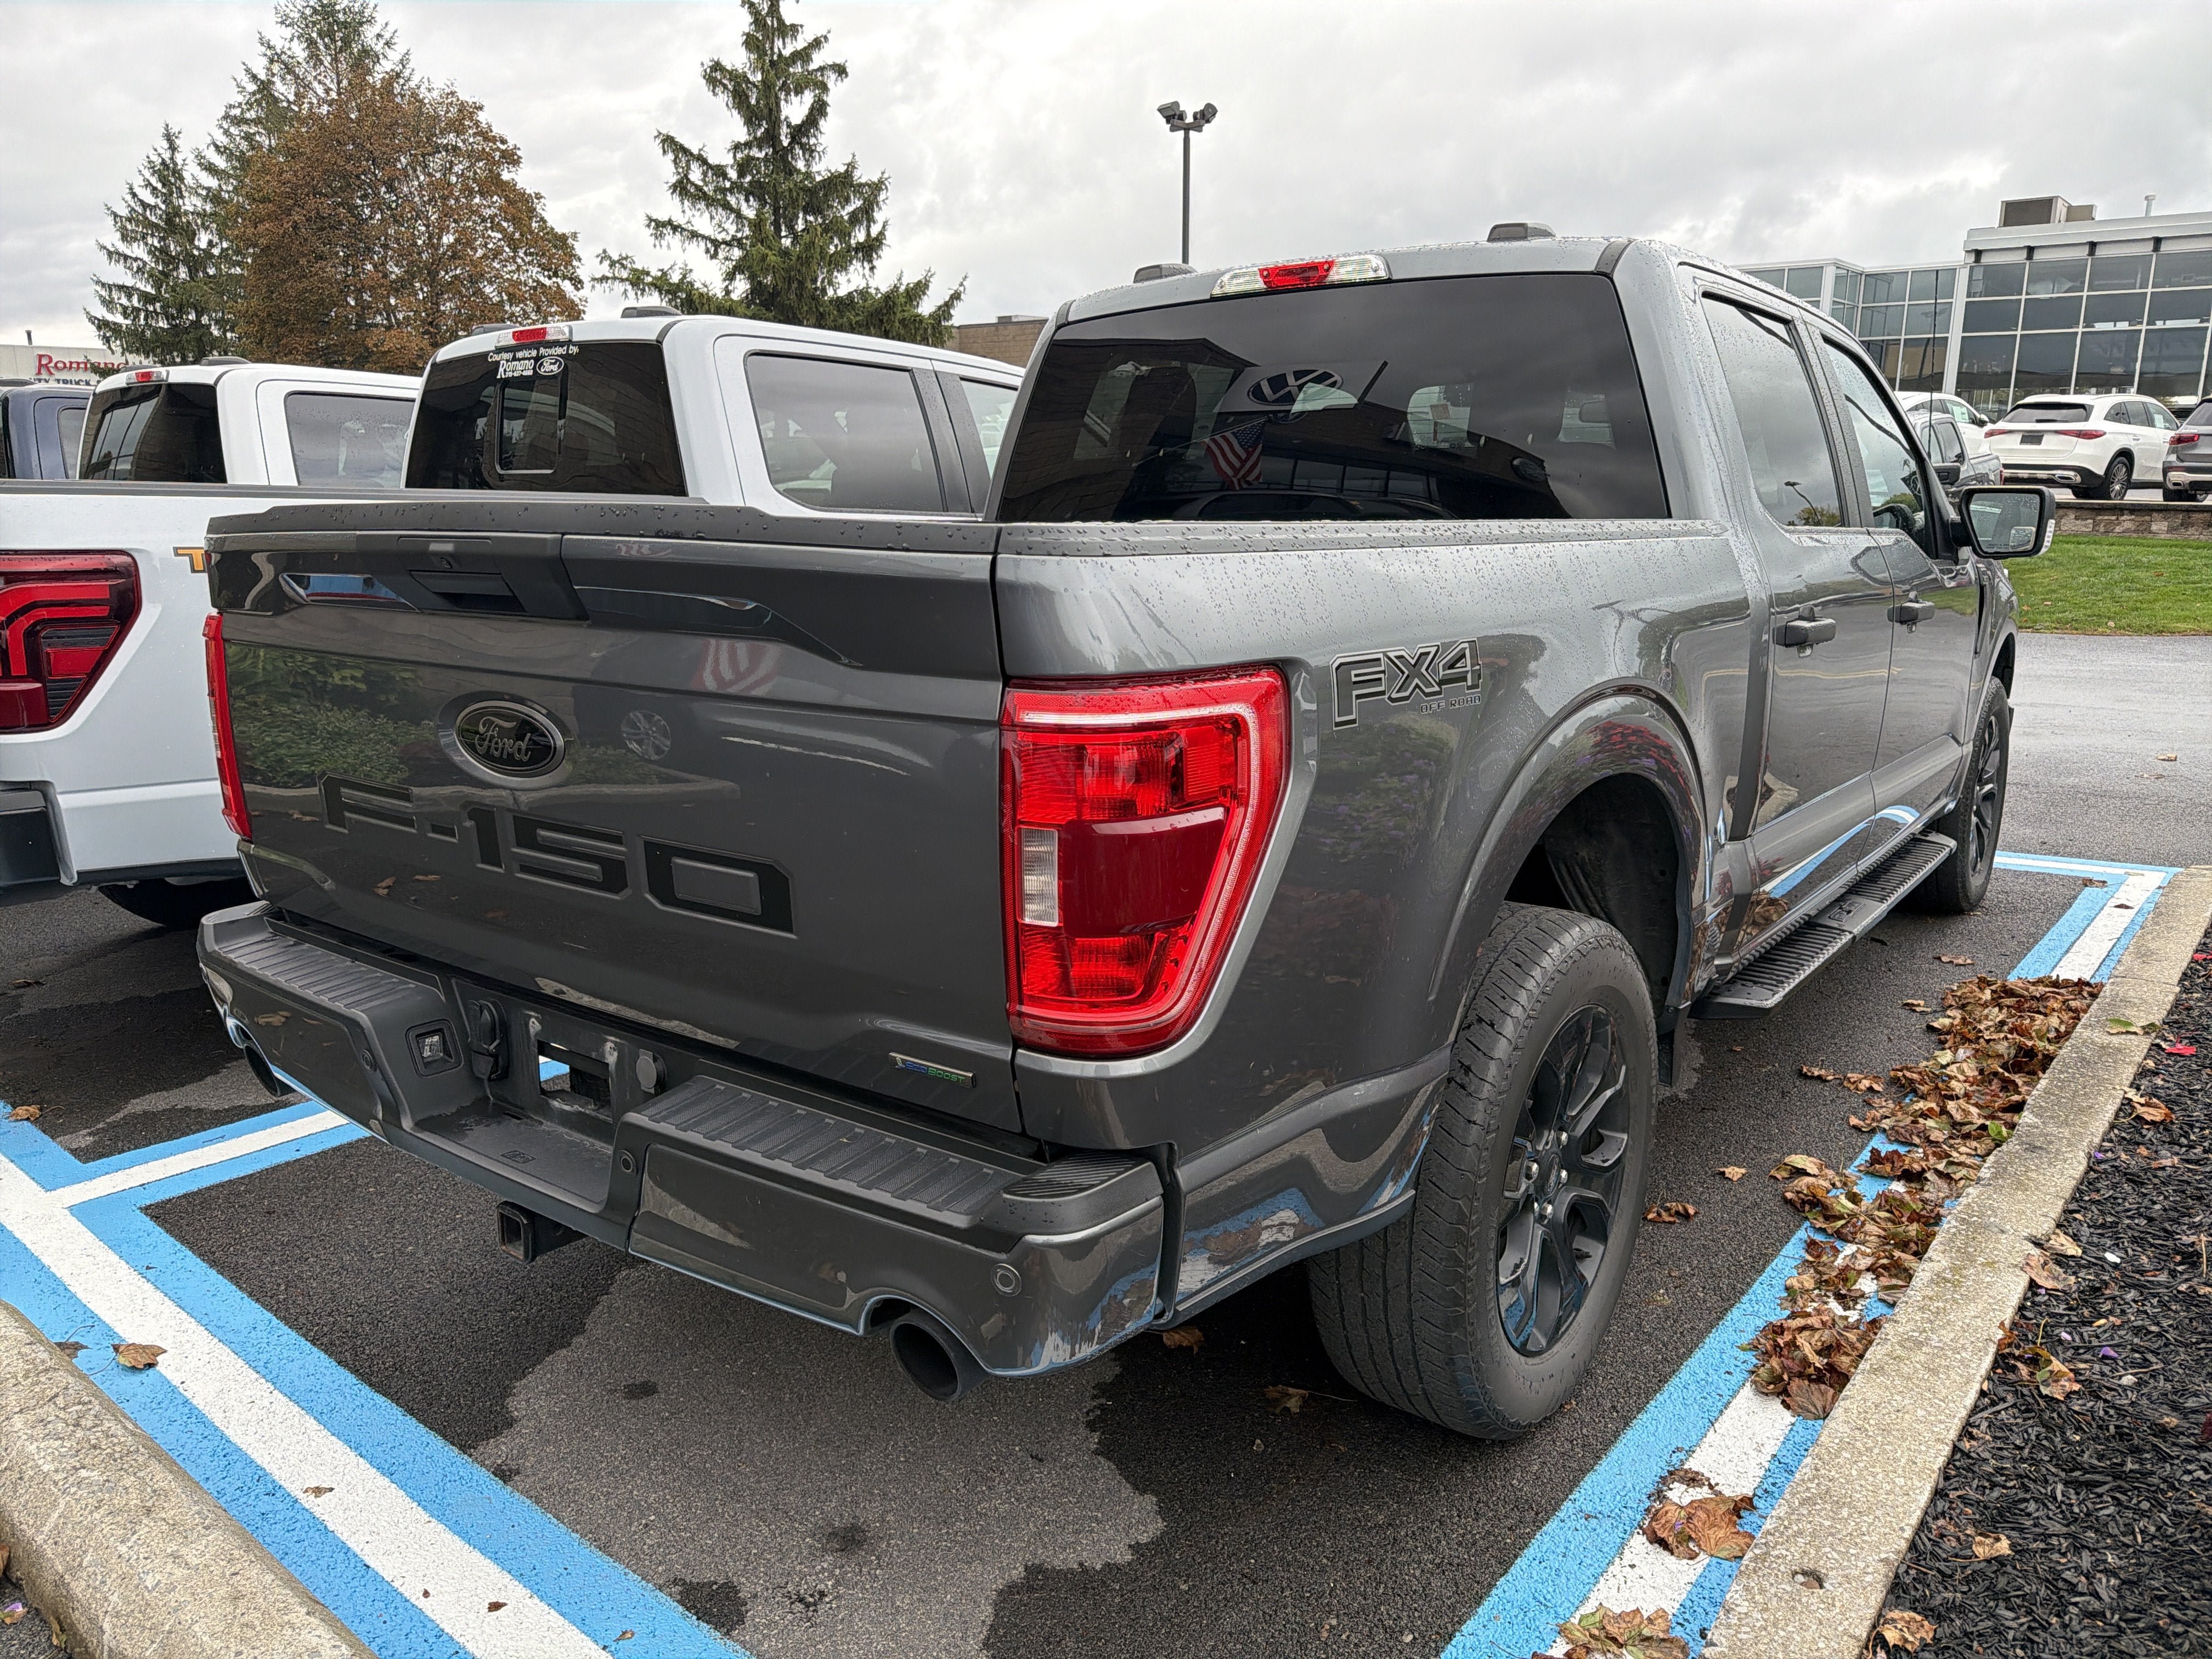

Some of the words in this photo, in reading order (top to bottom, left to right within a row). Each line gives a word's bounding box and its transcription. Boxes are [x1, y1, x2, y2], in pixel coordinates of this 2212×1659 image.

[488, 352, 514, 362] Courtesy
[516, 348, 537, 358] vehicle
[539, 345, 567, 356] Provided
[569, 345, 579, 355] by:
[496, 359, 534, 379] Romano
[540, 358, 561, 373] Ford
[1329, 638, 1482, 730] FX4
[1420, 701, 1445, 714] OFF
[1450, 695, 1481, 709] ROAD
[474, 715, 532, 764] Ford
[318, 771, 798, 939] F-150
